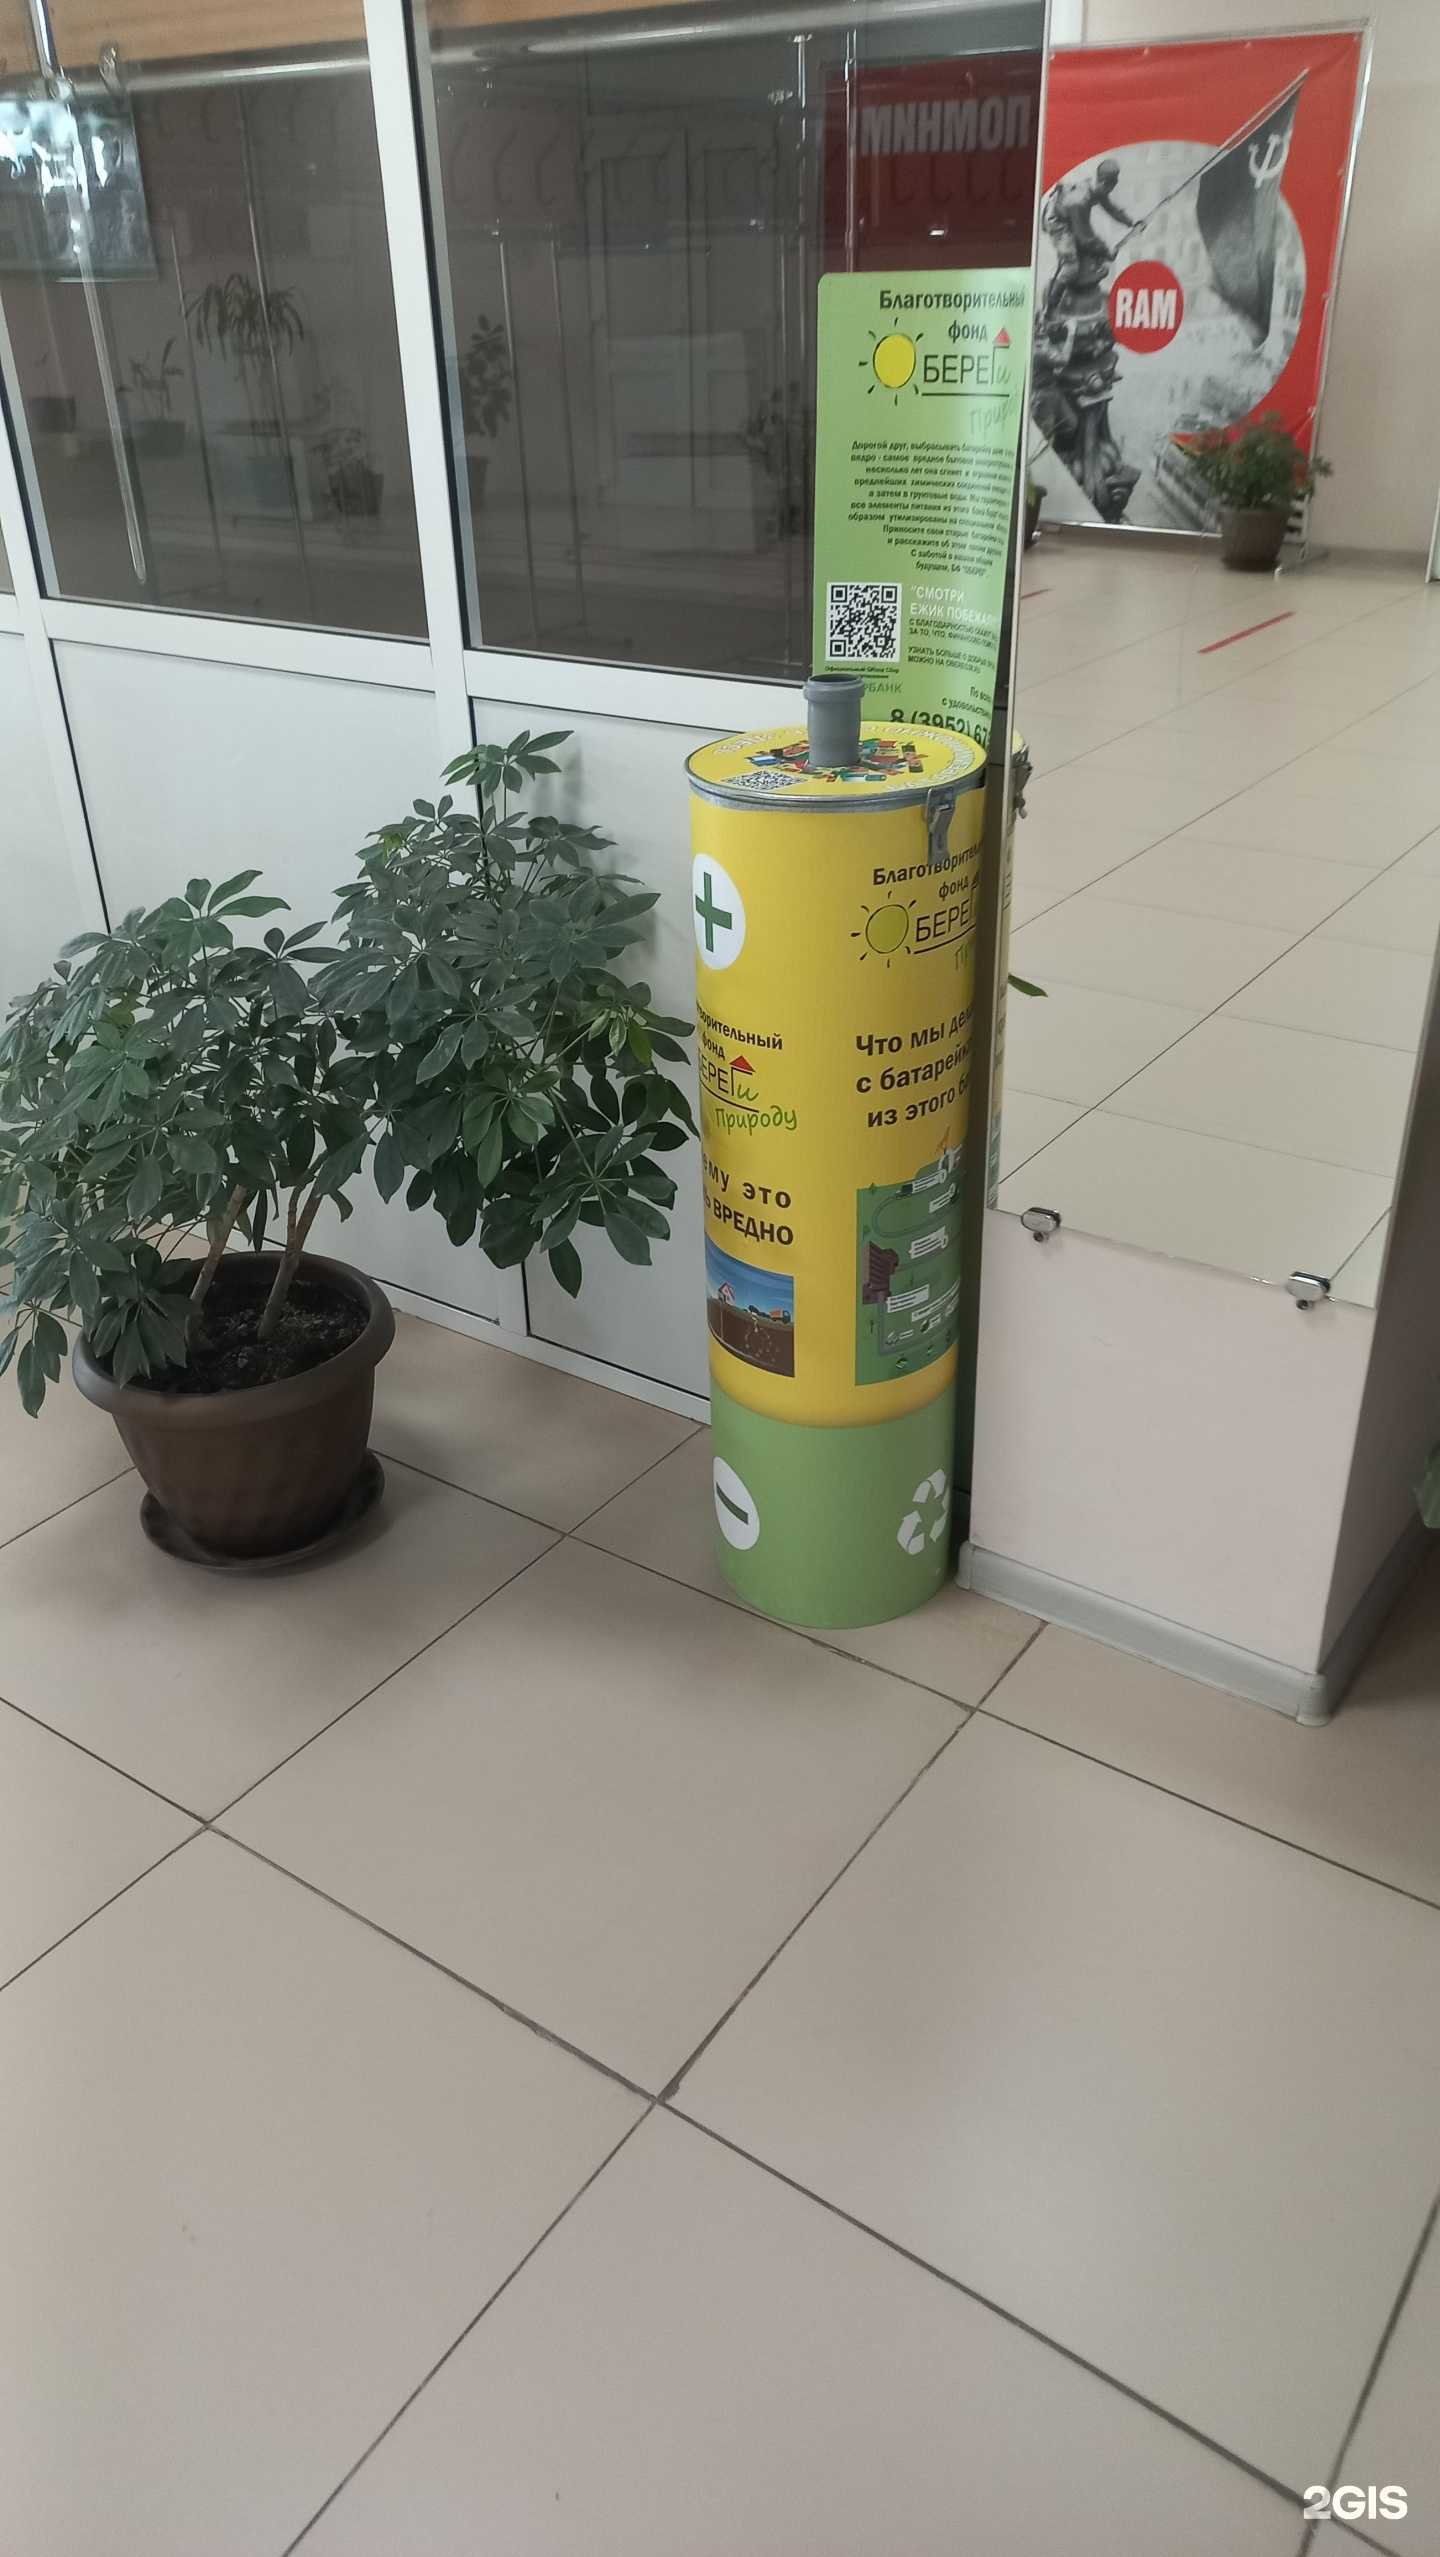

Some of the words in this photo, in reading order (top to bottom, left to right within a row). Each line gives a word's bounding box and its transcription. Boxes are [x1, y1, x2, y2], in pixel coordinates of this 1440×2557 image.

[948, 320, 988, 343] фонд
[910, 602, 944, 618] ЕЖИК
[856, 1033, 902, 1056] Что
[856, 1076, 872, 1094] с
[868, 1109, 898, 1128] из
[905, 1086, 956, 1121] этого
[714, 1105, 798, 1137] Природу
[742, 1182, 791, 1209] это
[713, 1197, 794, 1246] ВРЕДНО
